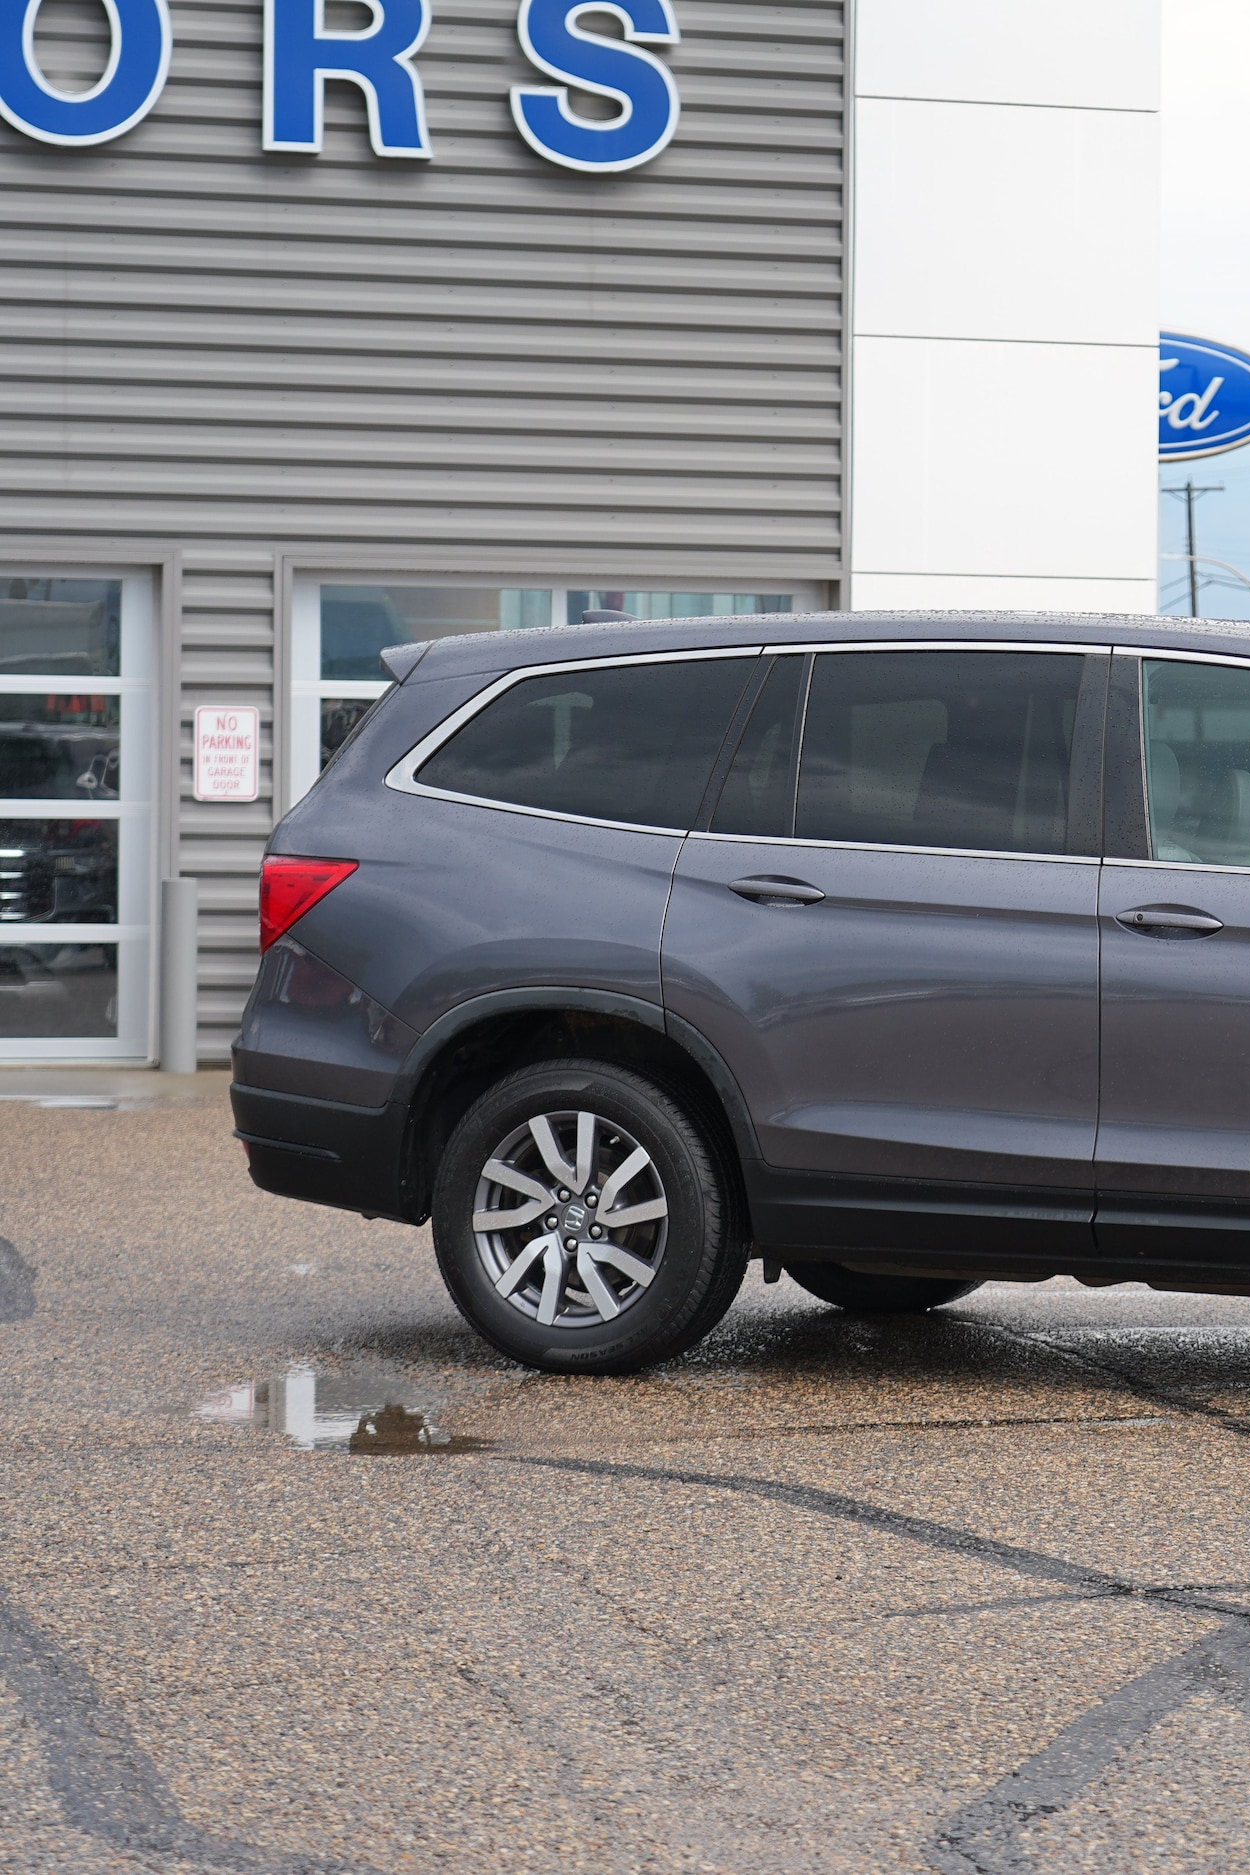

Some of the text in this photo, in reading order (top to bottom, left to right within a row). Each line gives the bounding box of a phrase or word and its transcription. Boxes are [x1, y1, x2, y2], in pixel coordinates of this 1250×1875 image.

[0, 0, 681, 173] ORS
[216, 715, 238, 731] NO
[202, 734, 252, 750] PARKING
[203, 754, 250, 764] IN FRONT OF
[207, 766, 247, 777] GARAGE
[212, 779, 240, 790] DOOR
